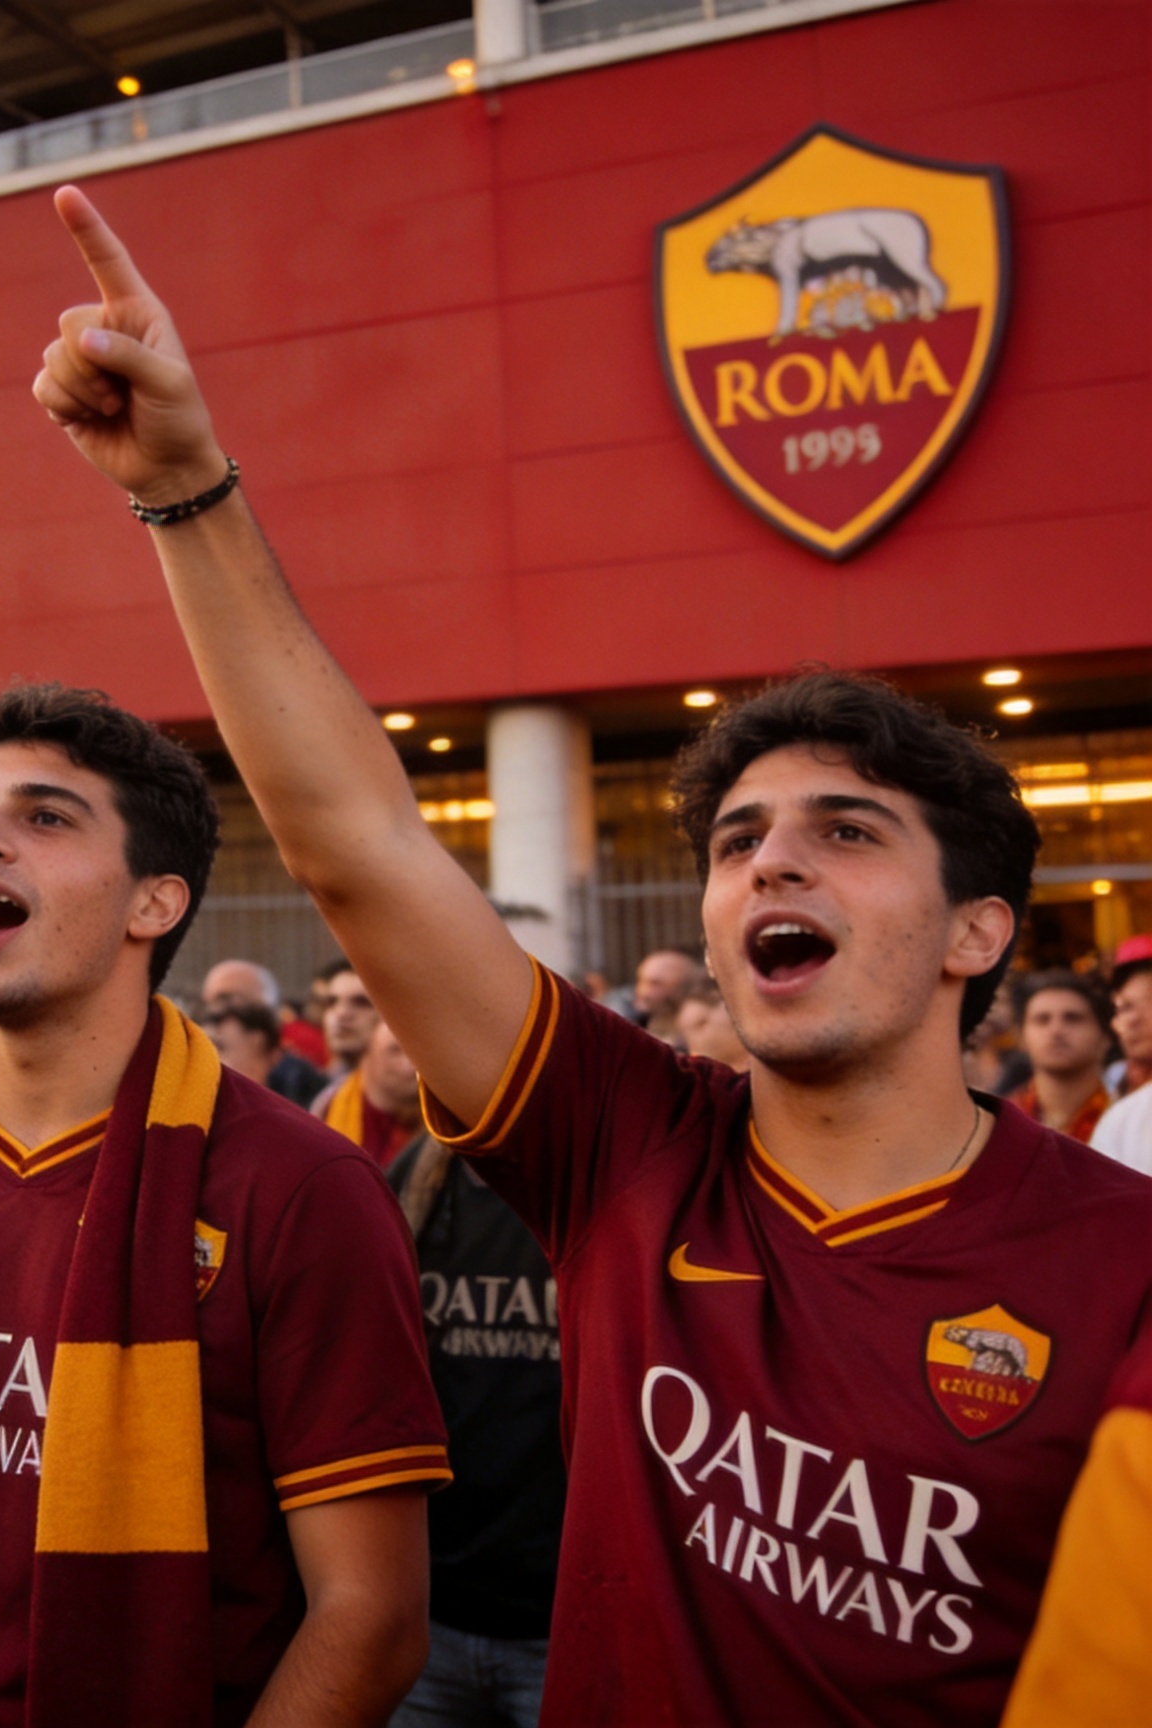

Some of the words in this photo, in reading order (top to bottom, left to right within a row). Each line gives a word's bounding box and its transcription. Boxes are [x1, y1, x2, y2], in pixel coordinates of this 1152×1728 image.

[716, 338, 953, 427] ROMA
[641, 1365, 984, 1588] QATAR
[685, 1502, 974, 1656] AIRWAYS
